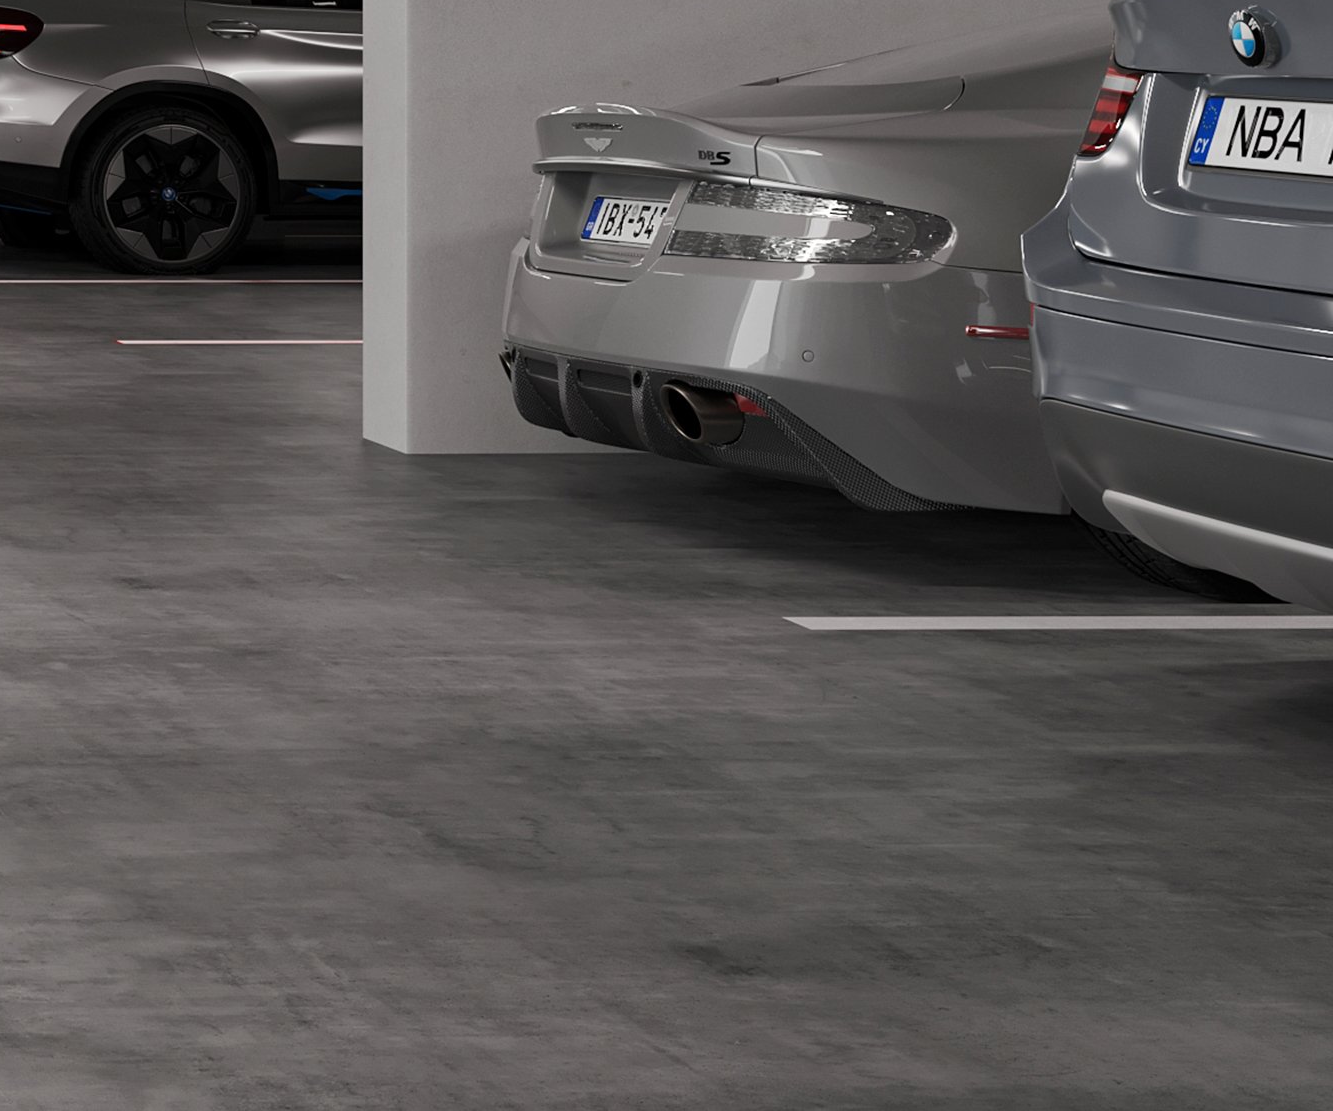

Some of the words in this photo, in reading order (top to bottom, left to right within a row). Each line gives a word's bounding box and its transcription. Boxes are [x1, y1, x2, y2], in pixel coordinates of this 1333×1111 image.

[1193, 138, 1209, 153] CY
[1225, 105, 1306, 162] NBA
[698, 150, 731, 165] DBS
[596, 203, 667, 239] IBX-54
